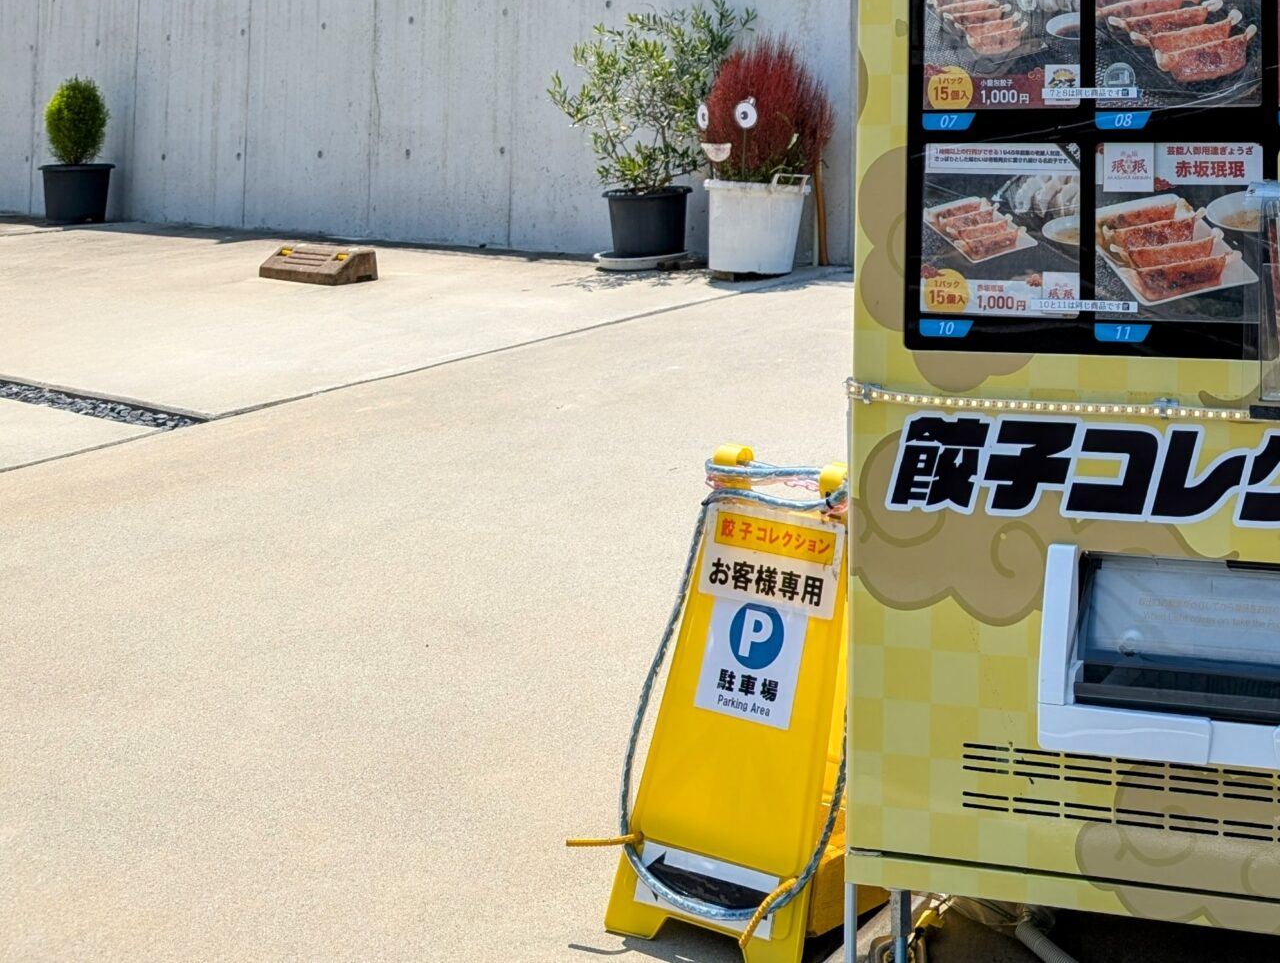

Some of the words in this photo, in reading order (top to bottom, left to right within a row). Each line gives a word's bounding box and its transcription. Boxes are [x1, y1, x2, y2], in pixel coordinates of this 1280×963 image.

[938, 77, 963, 85] 1パック
[933, 86, 970, 101] 15個入
[980, 90, 1030, 104] 1,000円
[940, 115, 958, 128] 07
[1114, 114, 1133, 127] 08
[1166, 146, 1254, 156] 芸能人御用達ぎょうざ
[1174, 160, 1246, 178] 赤坂珉珉
[934, 279, 961, 289] 1パック
[929, 289, 966, 305] 15個入
[977, 295, 1027, 311] 1,000円
[938, 322, 955, 335] 10
[1114, 326, 1132, 340] 11
[720, 516, 831, 555] 餃子コレクション
[708, 556, 825, 607] お客様専用
[738, 608, 774, 658] P
[716, 668, 779, 702] 駐車場
[716, 693, 749, 712] Parking
[750, 700, 771, 717] Area
